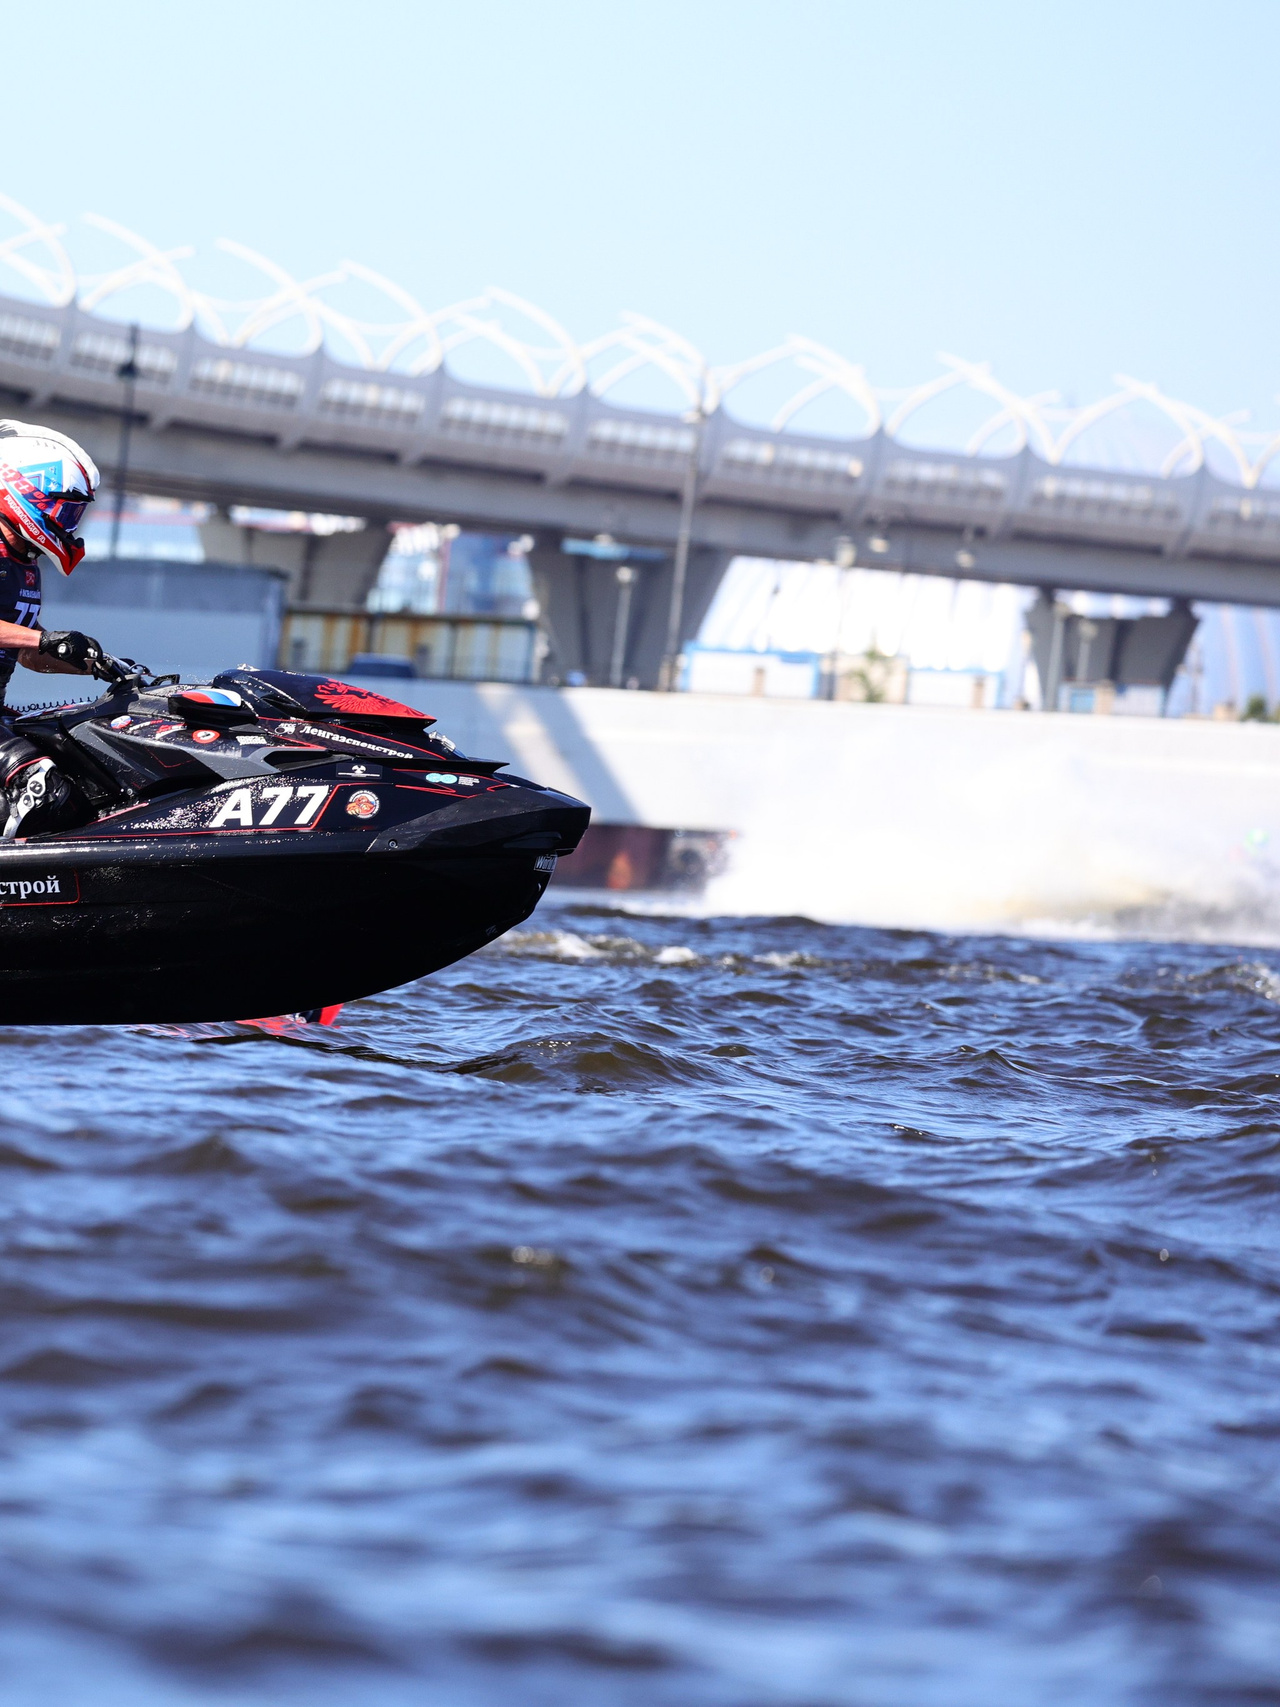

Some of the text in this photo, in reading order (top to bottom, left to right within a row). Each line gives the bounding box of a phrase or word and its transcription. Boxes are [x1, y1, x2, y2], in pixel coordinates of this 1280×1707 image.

[14, 601, 40, 629] 77
[299, 725, 414, 759] Ленгазспецстрой
[208, 784, 329, 828] A77
